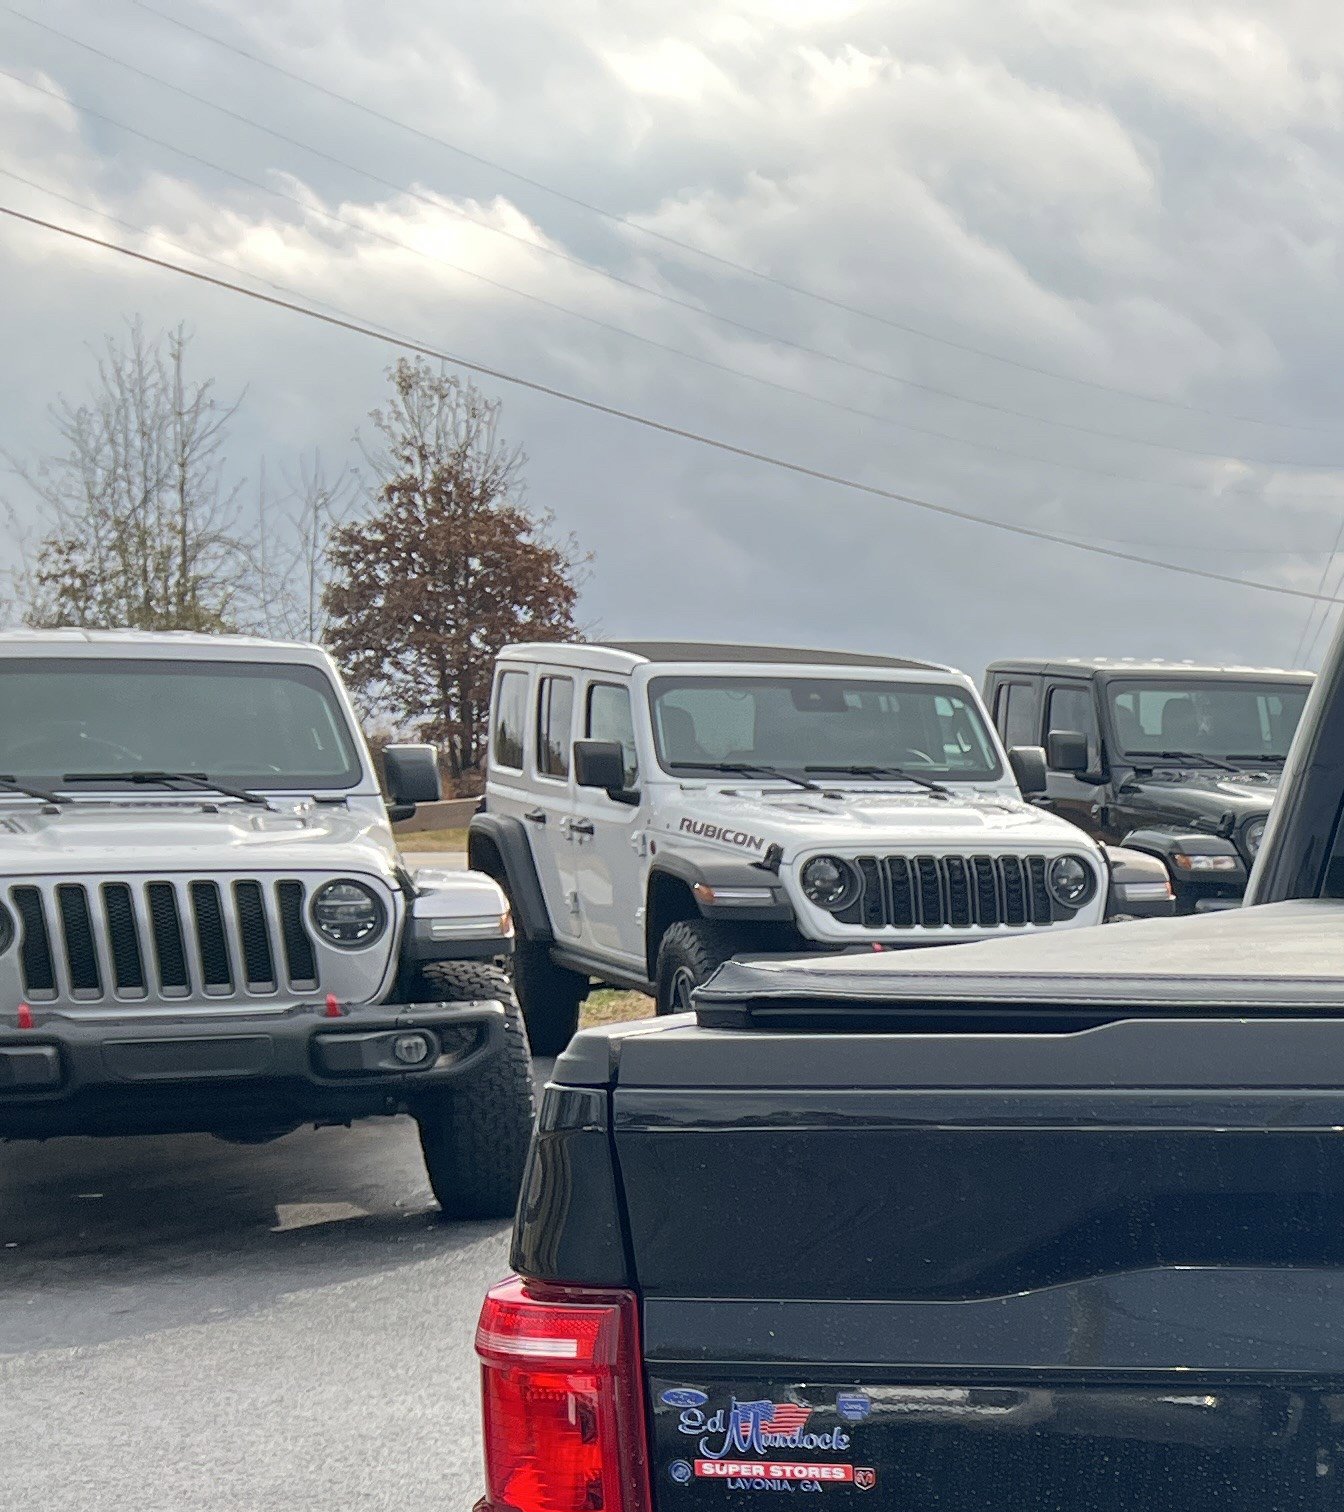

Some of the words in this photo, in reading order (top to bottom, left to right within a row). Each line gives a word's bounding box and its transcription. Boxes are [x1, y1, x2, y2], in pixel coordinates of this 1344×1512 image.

[679, 817, 765, 850] RUBICON
[677, 1408, 726, 1435] Ed
[699, 1409, 851, 1460] Murdock
[701, 1463, 765, 1477] SUPER
[769, 1465, 846, 1480] STORES
[726, 1478, 796, 1493] LAVONIA,
[800, 1480, 823, 1493] GA
